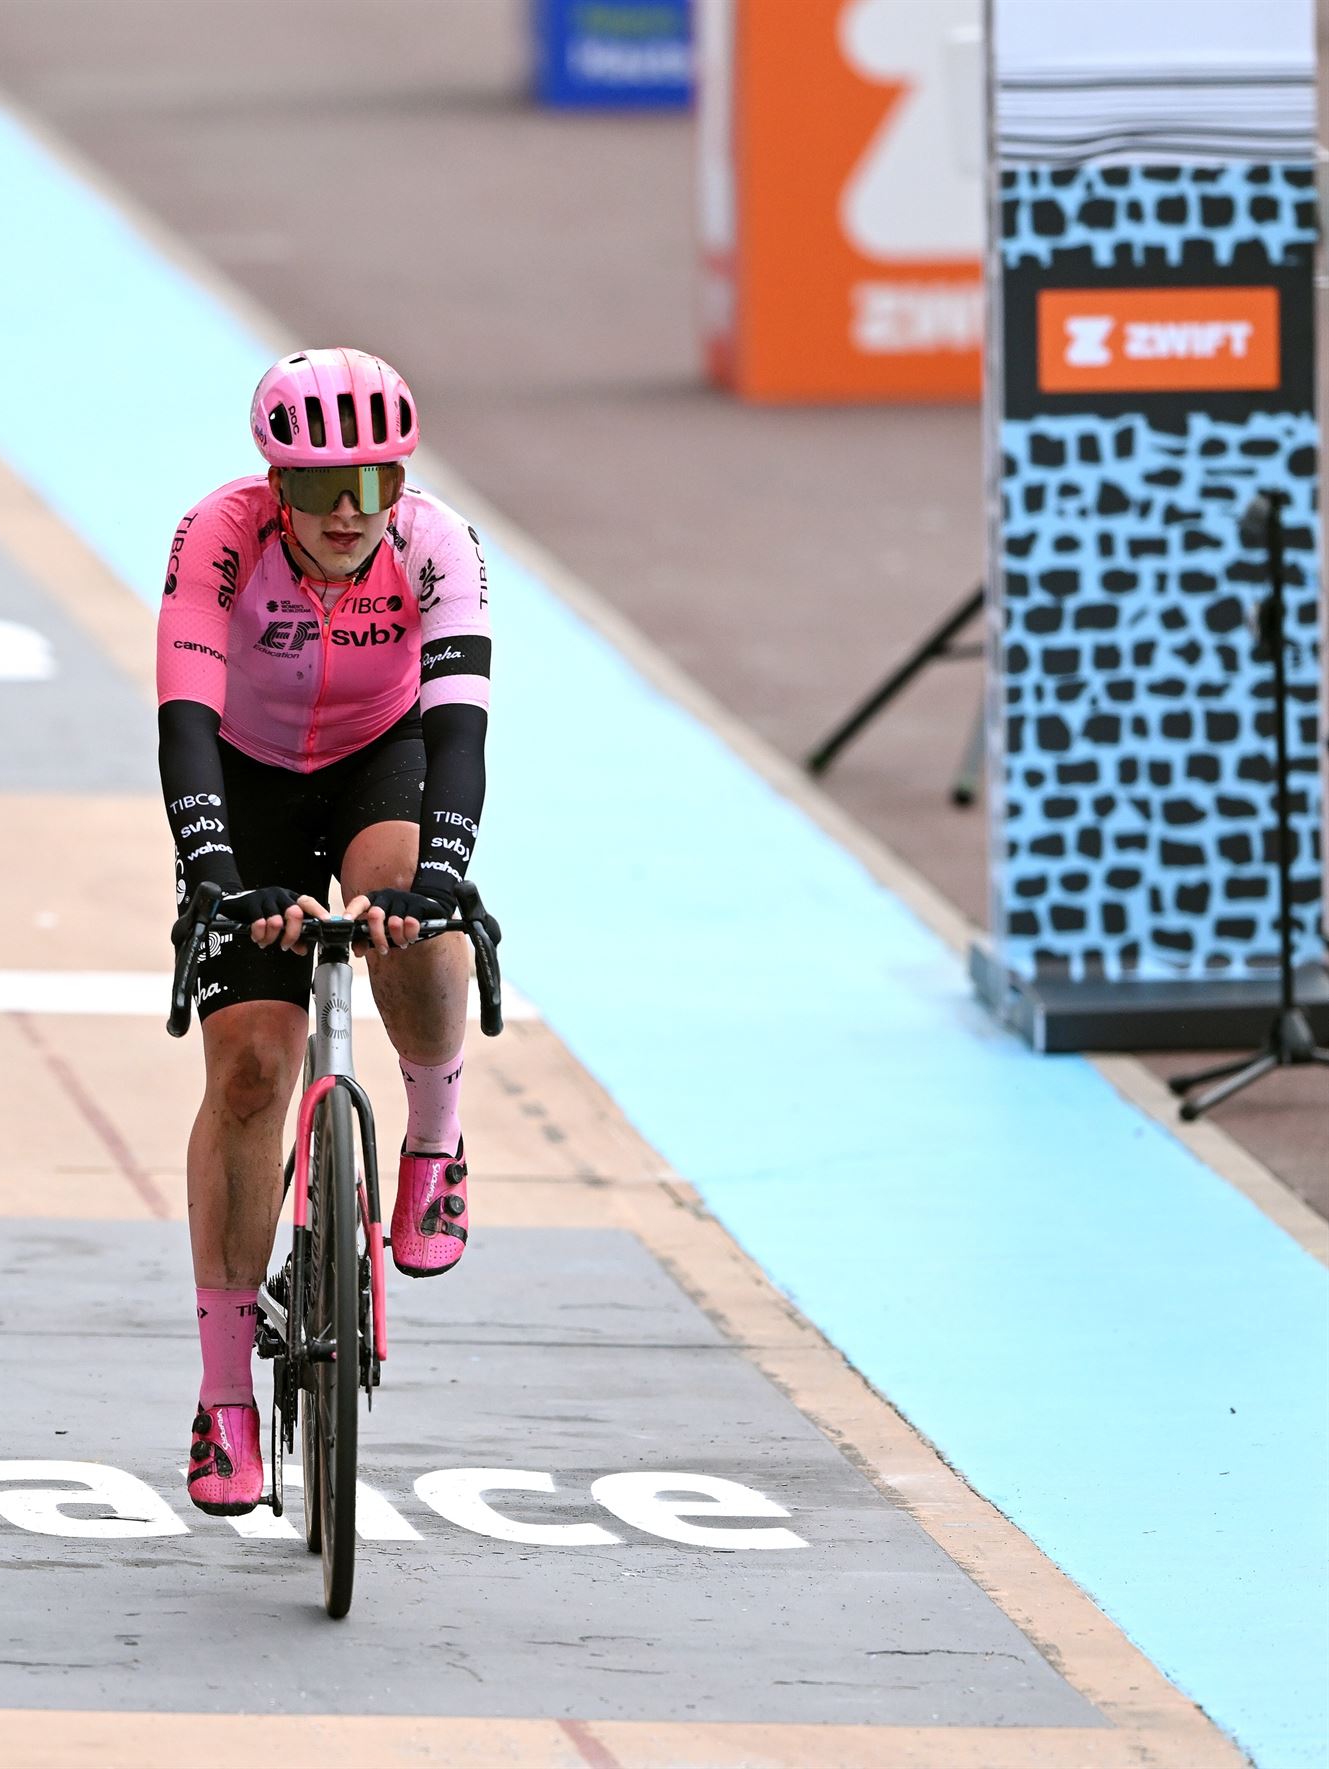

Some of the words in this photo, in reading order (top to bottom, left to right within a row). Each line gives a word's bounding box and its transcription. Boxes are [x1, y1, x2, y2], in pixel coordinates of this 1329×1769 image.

[1123, 320, 1253, 359] ZWIFT
[340, 595, 403, 614] TIBCO
[252, 644, 300, 660] Education
[169, 793, 222, 815] TIBCO
